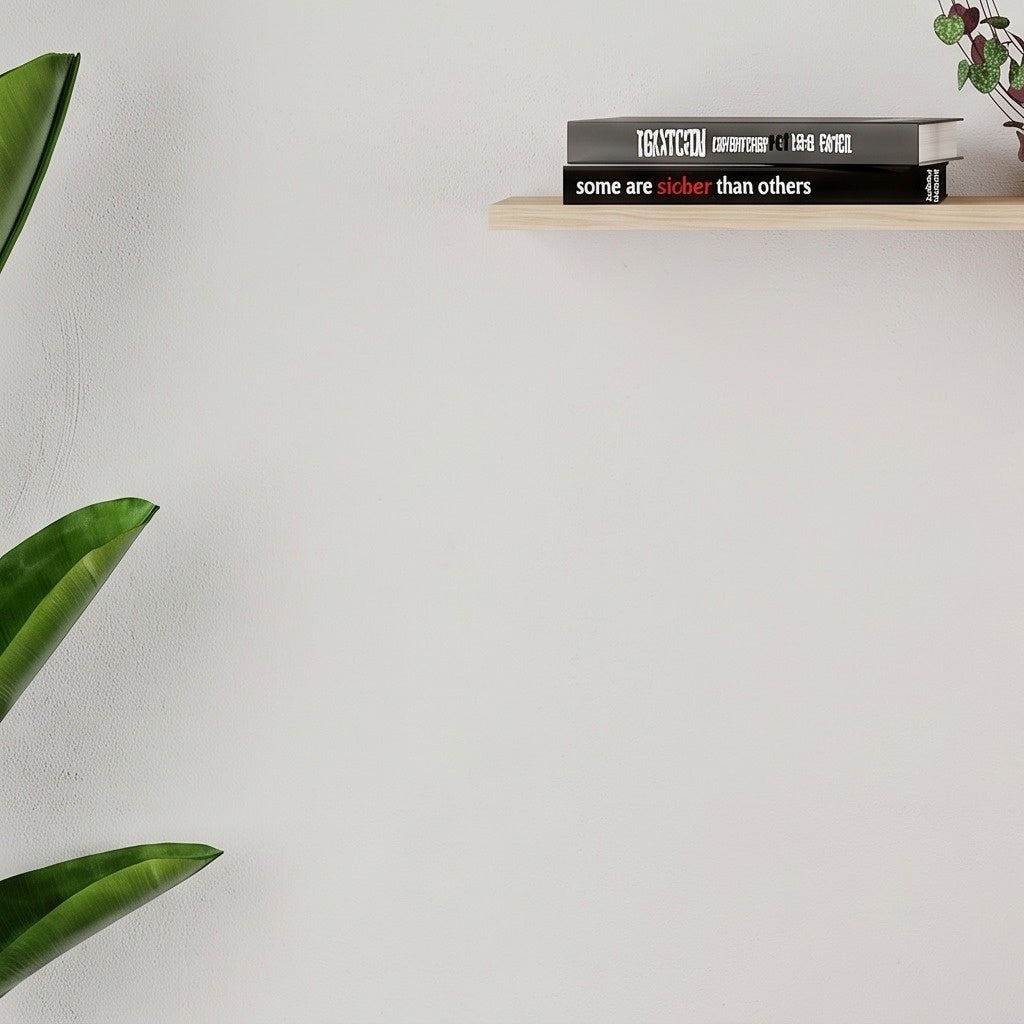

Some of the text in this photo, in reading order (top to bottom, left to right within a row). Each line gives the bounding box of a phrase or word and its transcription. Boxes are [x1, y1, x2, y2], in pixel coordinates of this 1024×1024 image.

[575, 180, 622, 195] some
[625, 180, 653, 195] are
[716, 175, 754, 195] than
[757, 175, 812, 195] others
